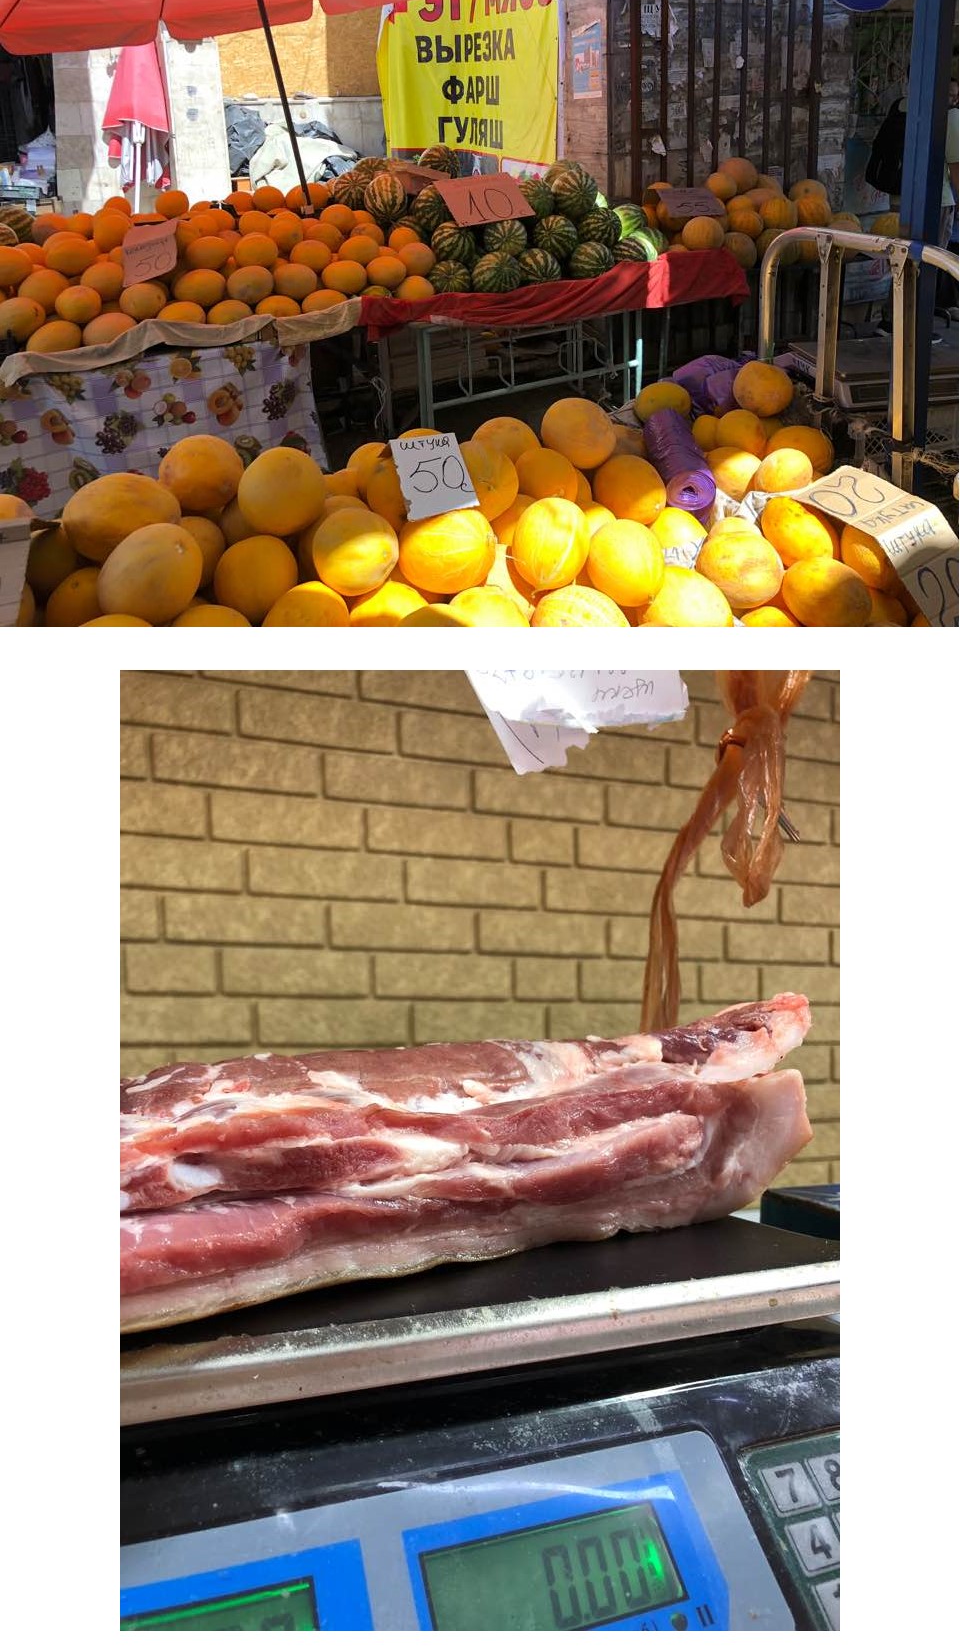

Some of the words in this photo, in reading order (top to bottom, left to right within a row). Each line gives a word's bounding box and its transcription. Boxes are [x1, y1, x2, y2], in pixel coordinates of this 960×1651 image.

[415, 28, 516, 64] ВЫРЕЗКА
[442, 75, 500, 106] ФАРШ
[437, 116, 504, 150] ГУЛЯШ
[468, 188, 513, 222] 10
[774, 1467, 798, 1503] 7
[809, 1524, 832, 1559] 4
